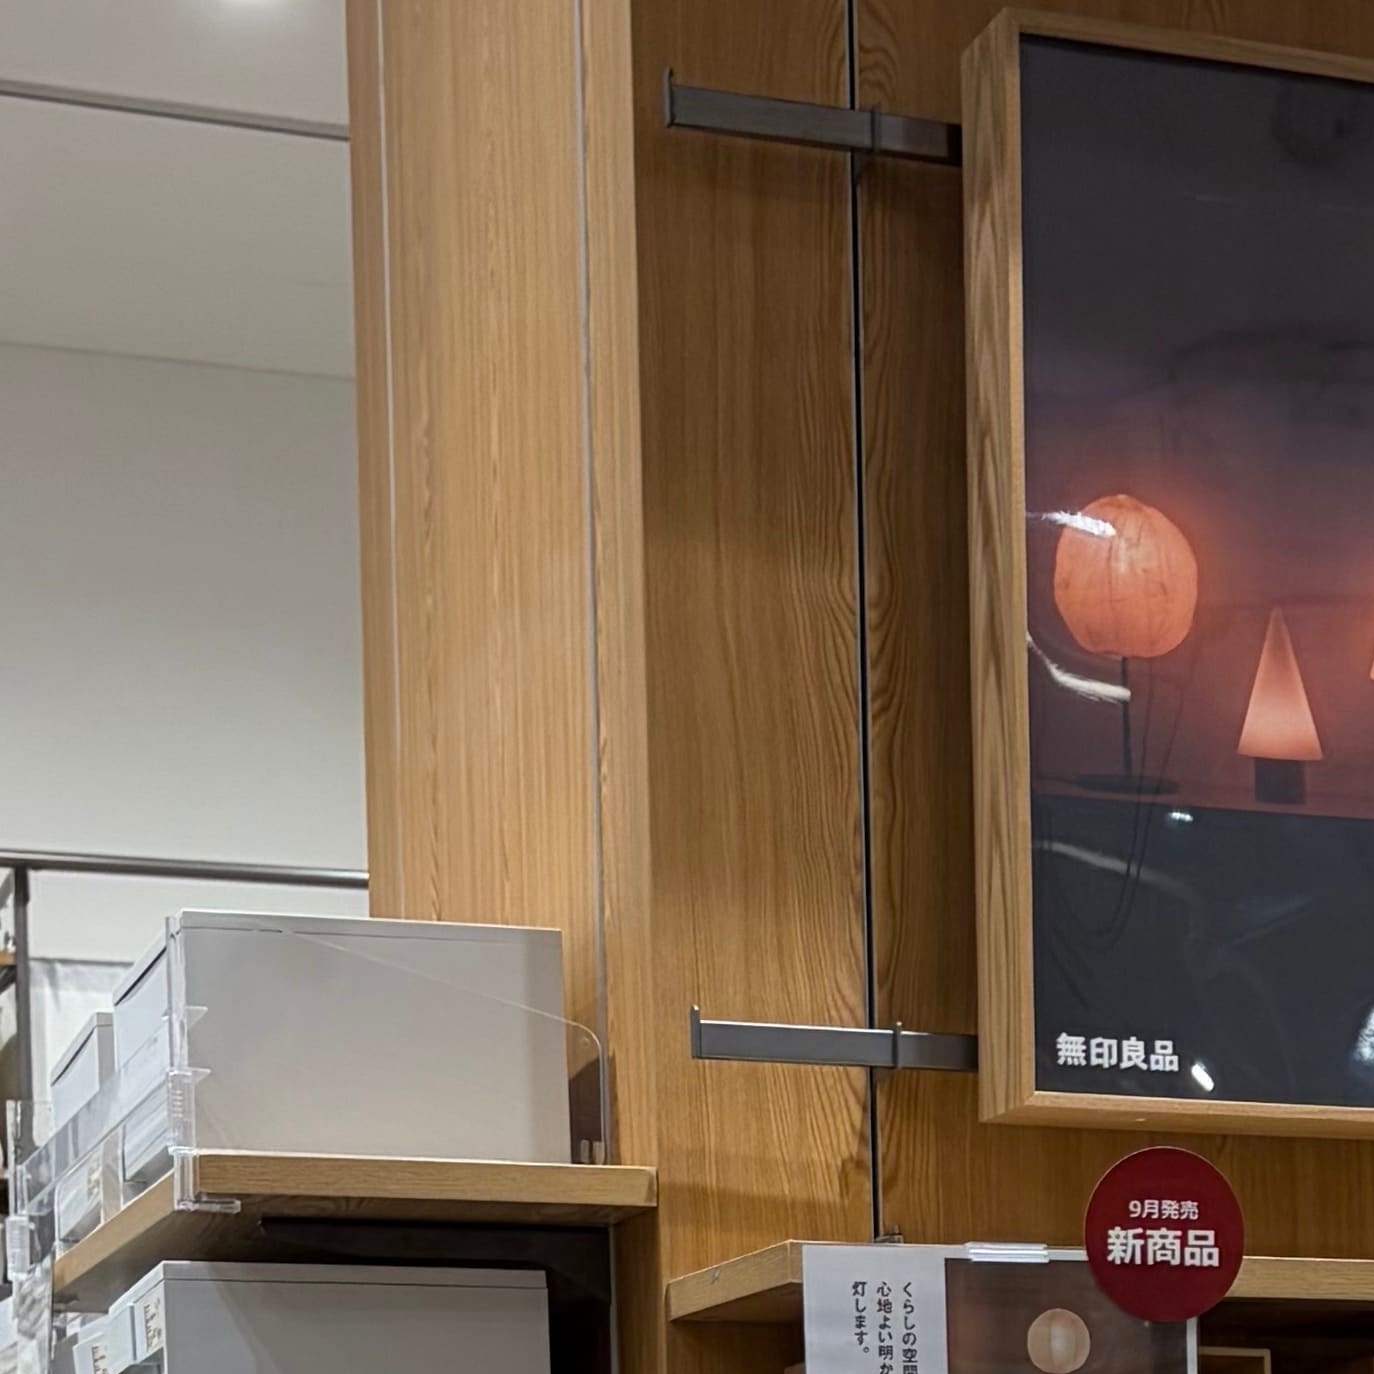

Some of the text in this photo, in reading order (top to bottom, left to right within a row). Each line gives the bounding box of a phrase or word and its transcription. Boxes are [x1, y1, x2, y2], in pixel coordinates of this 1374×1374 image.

[1055, 1031, 1179, 1072] 無印良品
[1128, 1199, 1199, 1220] 9月発売
[1106, 1226, 1220, 1267] 新商品
[852, 1281, 870, 1354] 灯します。
